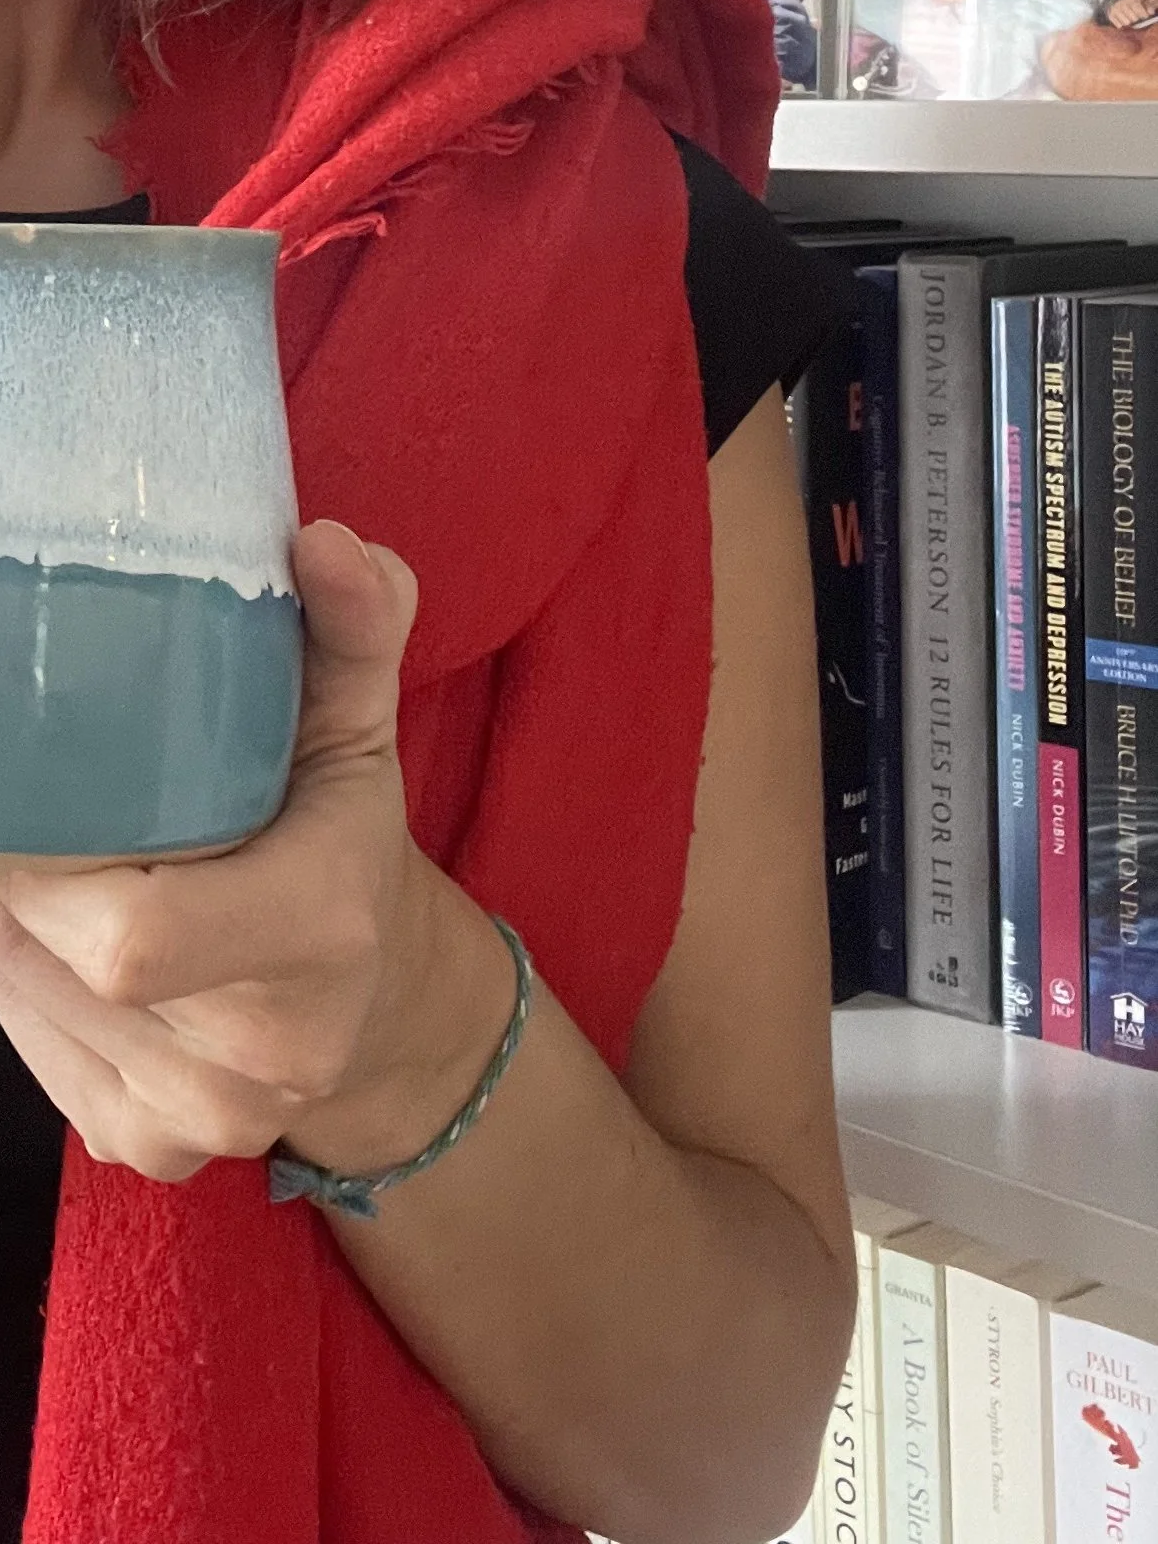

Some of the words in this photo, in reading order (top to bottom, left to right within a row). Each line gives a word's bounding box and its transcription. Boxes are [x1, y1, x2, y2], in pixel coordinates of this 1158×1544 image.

[919, 270, 947, 399] JORDAN
[1111, 331, 1135, 382] THE
[1044, 361, 1066, 394] THE
[925, 412, 948, 438] B.
[1044, 398, 1066, 468] AUTISM
[1111, 388, 1135, 500] BIOLOGY
[926, 450, 950, 615] PETERSON
[1044, 471, 1068, 569] SPECTRUM
[1113, 506, 1136, 542] OF
[1045, 572, 1068, 608] AND
[1113, 547, 1137, 628] BELIEF
[929, 636, 949, 663] 12
[1046, 613, 1068, 726] DEPRESSION
[929, 675, 952, 773] RULES
[1011, 712, 1024, 751] NICK
[1116, 704, 1139, 781] BRUCE
[1011, 757, 1025, 808] DUBIN
[1051, 759, 1065, 798] NICK
[930, 782, 952, 845] FOR
[1051, 804, 1066, 855] DUBIN
[1116, 812, 1139, 896] LIPTON
[930, 855, 953, 927] LIFE
[1113, 1018, 1146, 1038] HAY
[884, 1280, 933, 1309] GRANTA
[903, 1322, 925, 1346] A
[987, 1312, 1002, 1390] STYRON
[903, 1357, 930, 1433] Book
[1065, 1368, 1156, 1417] GILBERT
[1086, 1350, 1139, 1386] PAUL
[833, 1431, 858, 1544] STOIC
[905, 1441, 932, 1479] of
[1105, 1480, 1132, 1544] The
